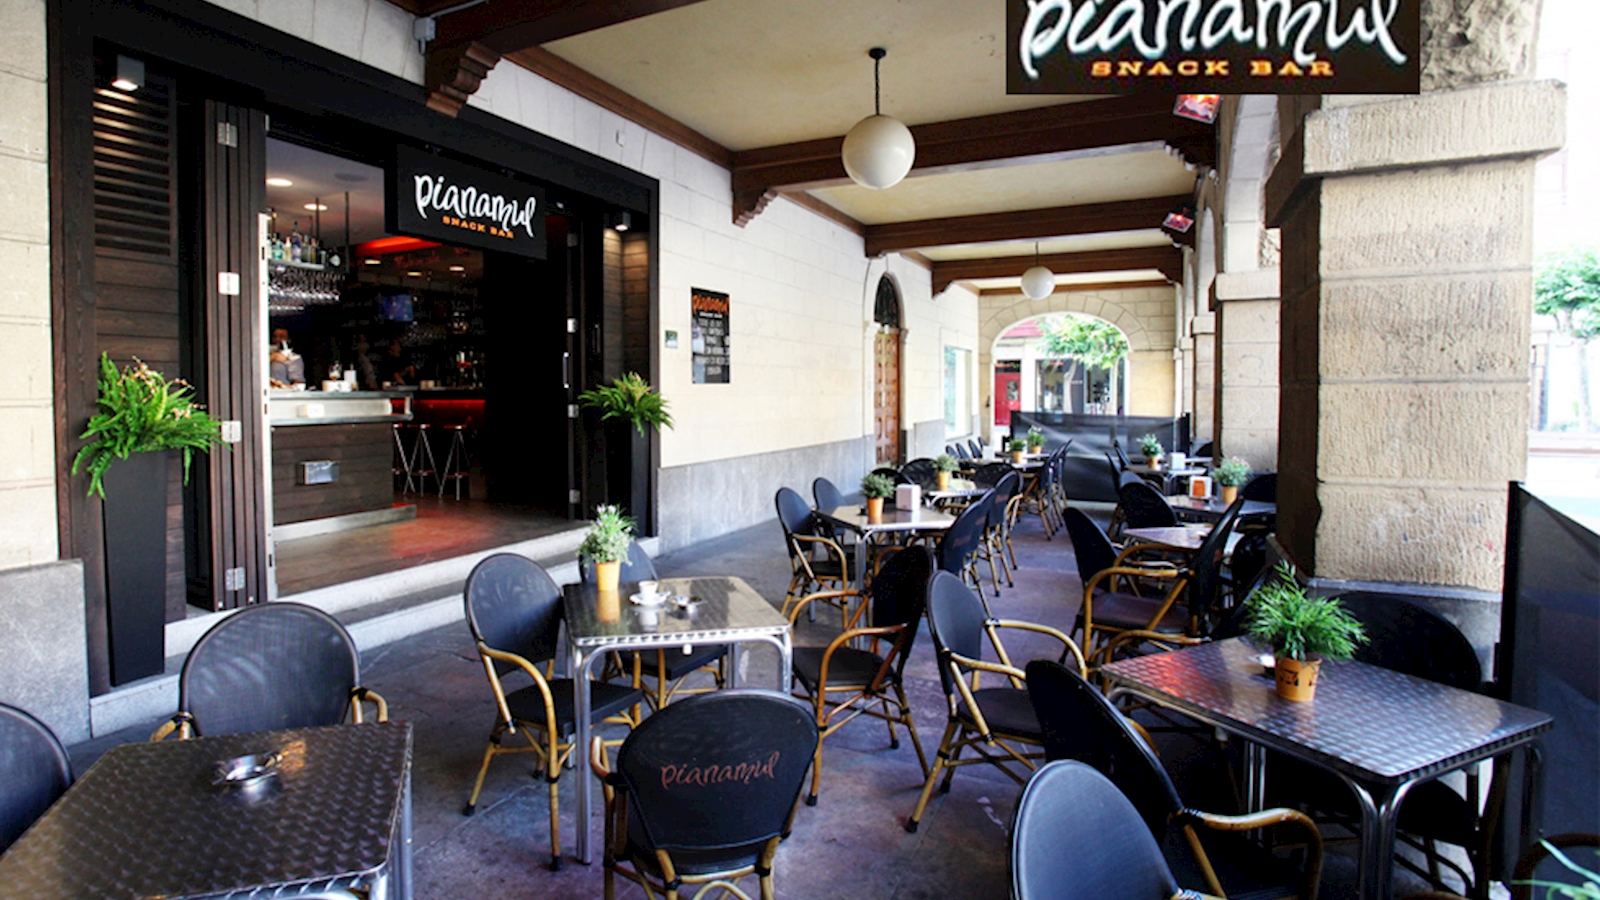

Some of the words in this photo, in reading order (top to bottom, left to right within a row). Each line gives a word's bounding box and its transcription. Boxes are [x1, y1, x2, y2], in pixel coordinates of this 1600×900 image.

[414, 175, 537, 238] pianamul
[442, 216, 486, 232] SNACK
[489, 226, 514, 239] BAR
[660, 751, 780, 790] pianamul
